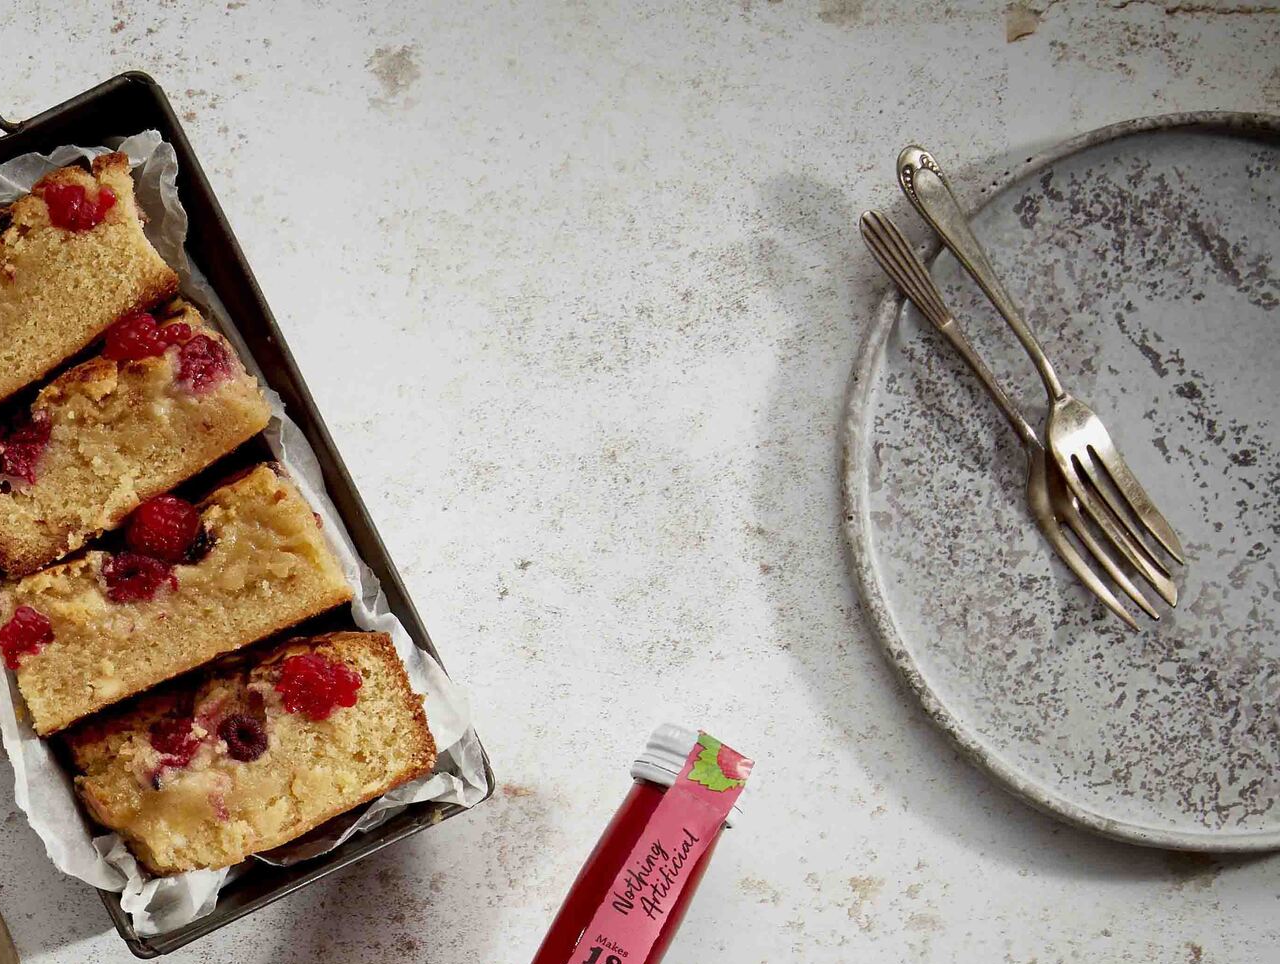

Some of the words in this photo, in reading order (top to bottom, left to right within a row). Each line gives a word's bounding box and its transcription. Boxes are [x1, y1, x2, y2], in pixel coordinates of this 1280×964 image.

[612, 839, 669, 915] Nothing
[640, 828, 700, 920] Artificial
[595, 934, 629, 958] Makes
